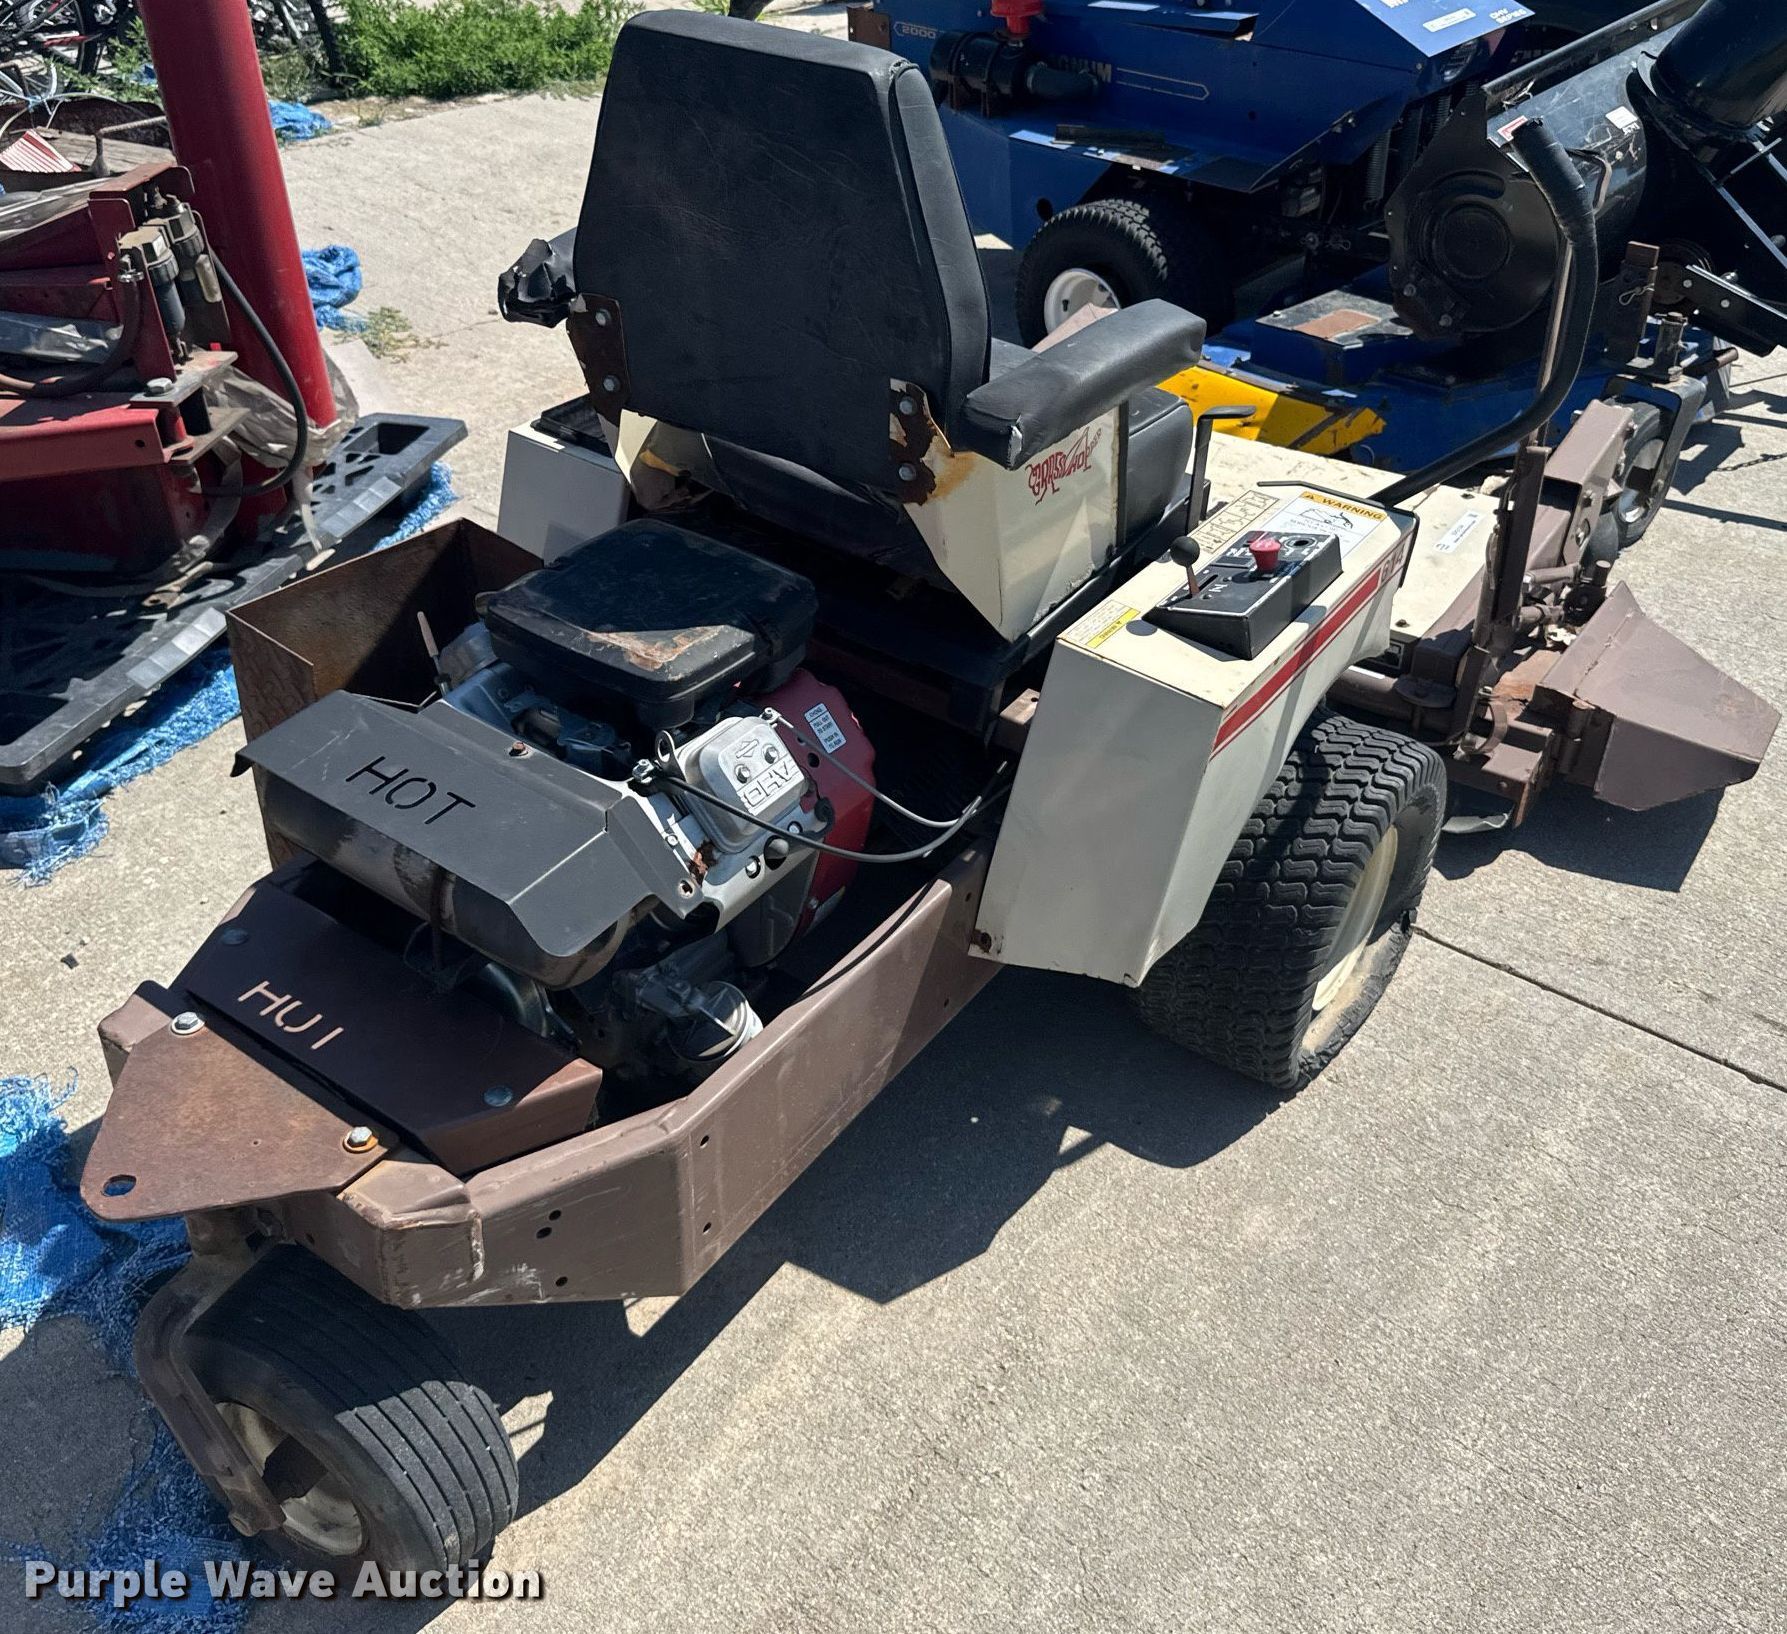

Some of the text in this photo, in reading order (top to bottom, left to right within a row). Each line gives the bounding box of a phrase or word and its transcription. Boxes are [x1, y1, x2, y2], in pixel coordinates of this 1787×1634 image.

[902, 24, 937, 40] 2000
[1322, 498, 1383, 520] WARNING
[345, 756, 476, 825] HOT
